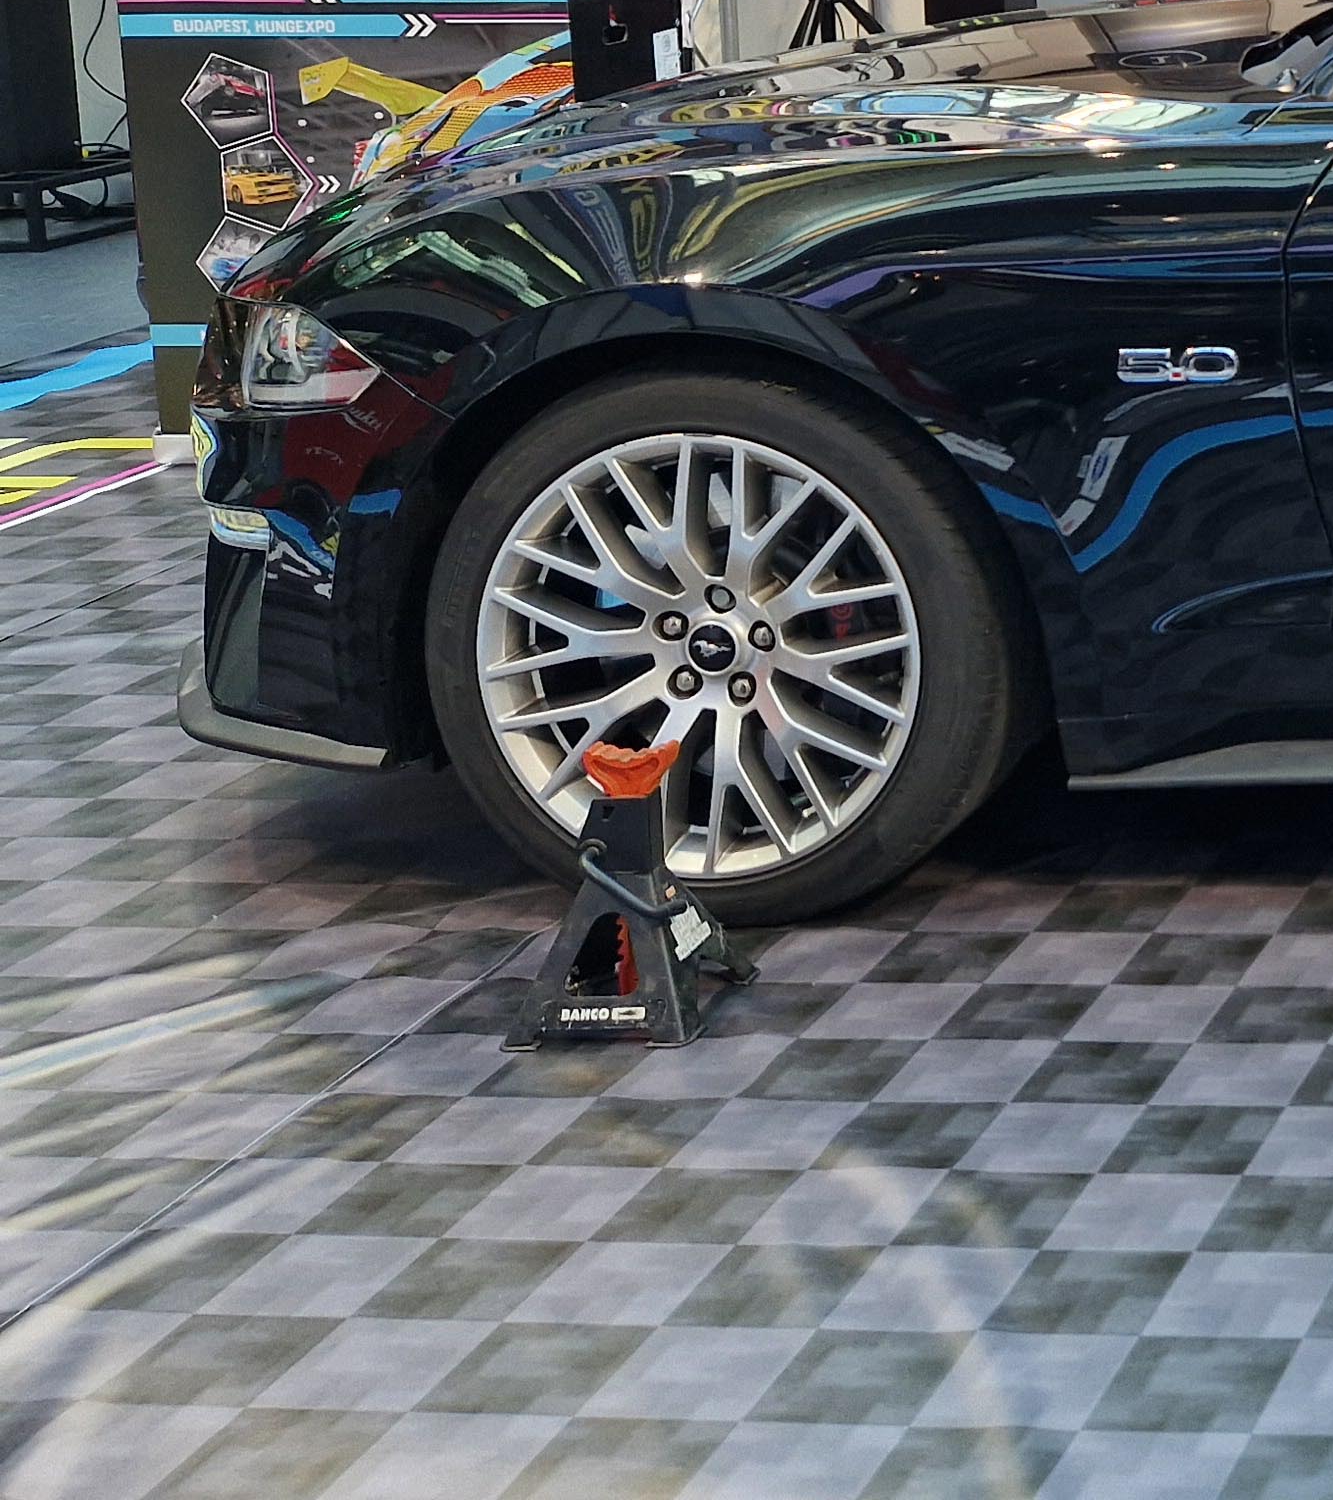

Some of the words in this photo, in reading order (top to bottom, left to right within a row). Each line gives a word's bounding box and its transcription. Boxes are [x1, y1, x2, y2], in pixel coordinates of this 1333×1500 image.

[173, 19, 251, 36] BUDAPEST,
[255, 19, 336, 34] HUNGEXPO
[1116, 346, 1240, 383] 5.0
